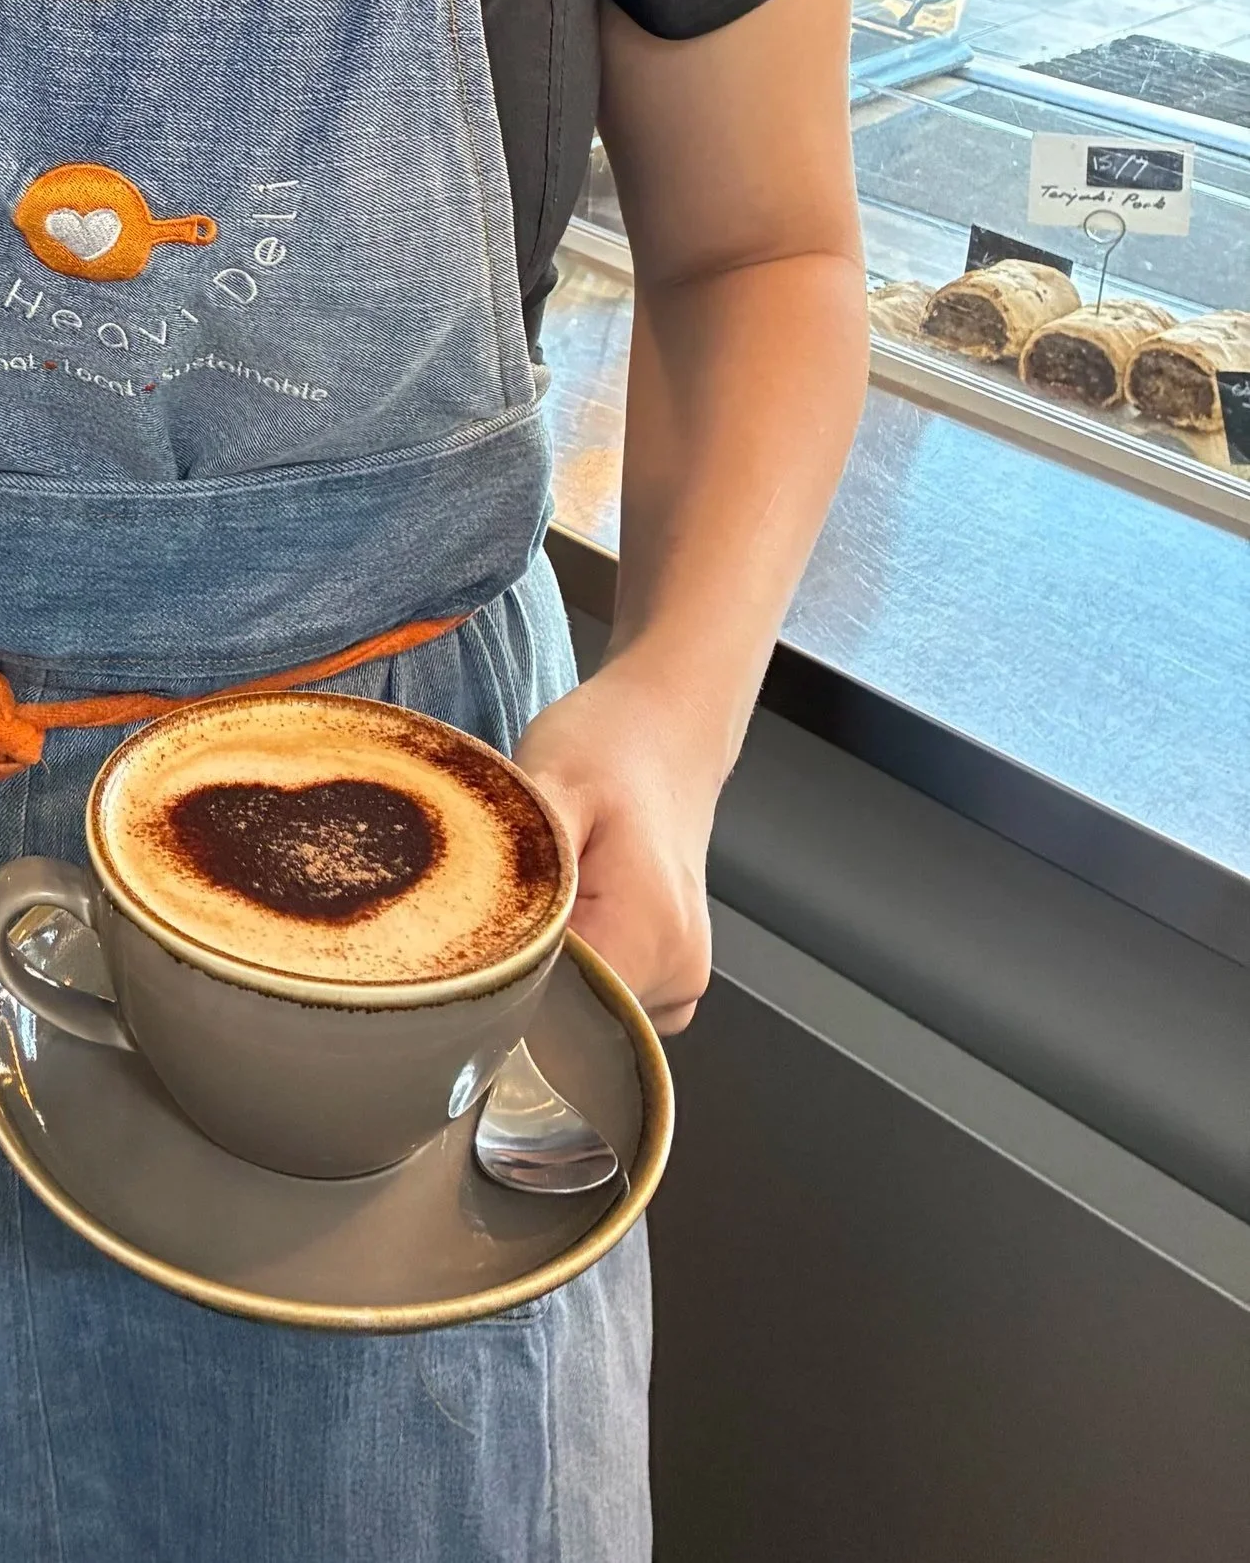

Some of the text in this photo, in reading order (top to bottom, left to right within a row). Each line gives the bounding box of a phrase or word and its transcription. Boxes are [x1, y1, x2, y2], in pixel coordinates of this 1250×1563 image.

[1121, 192, 1167, 211] Pork
[2, 277, 200, 353] Heavi
[213, 178, 301, 306] Deli
